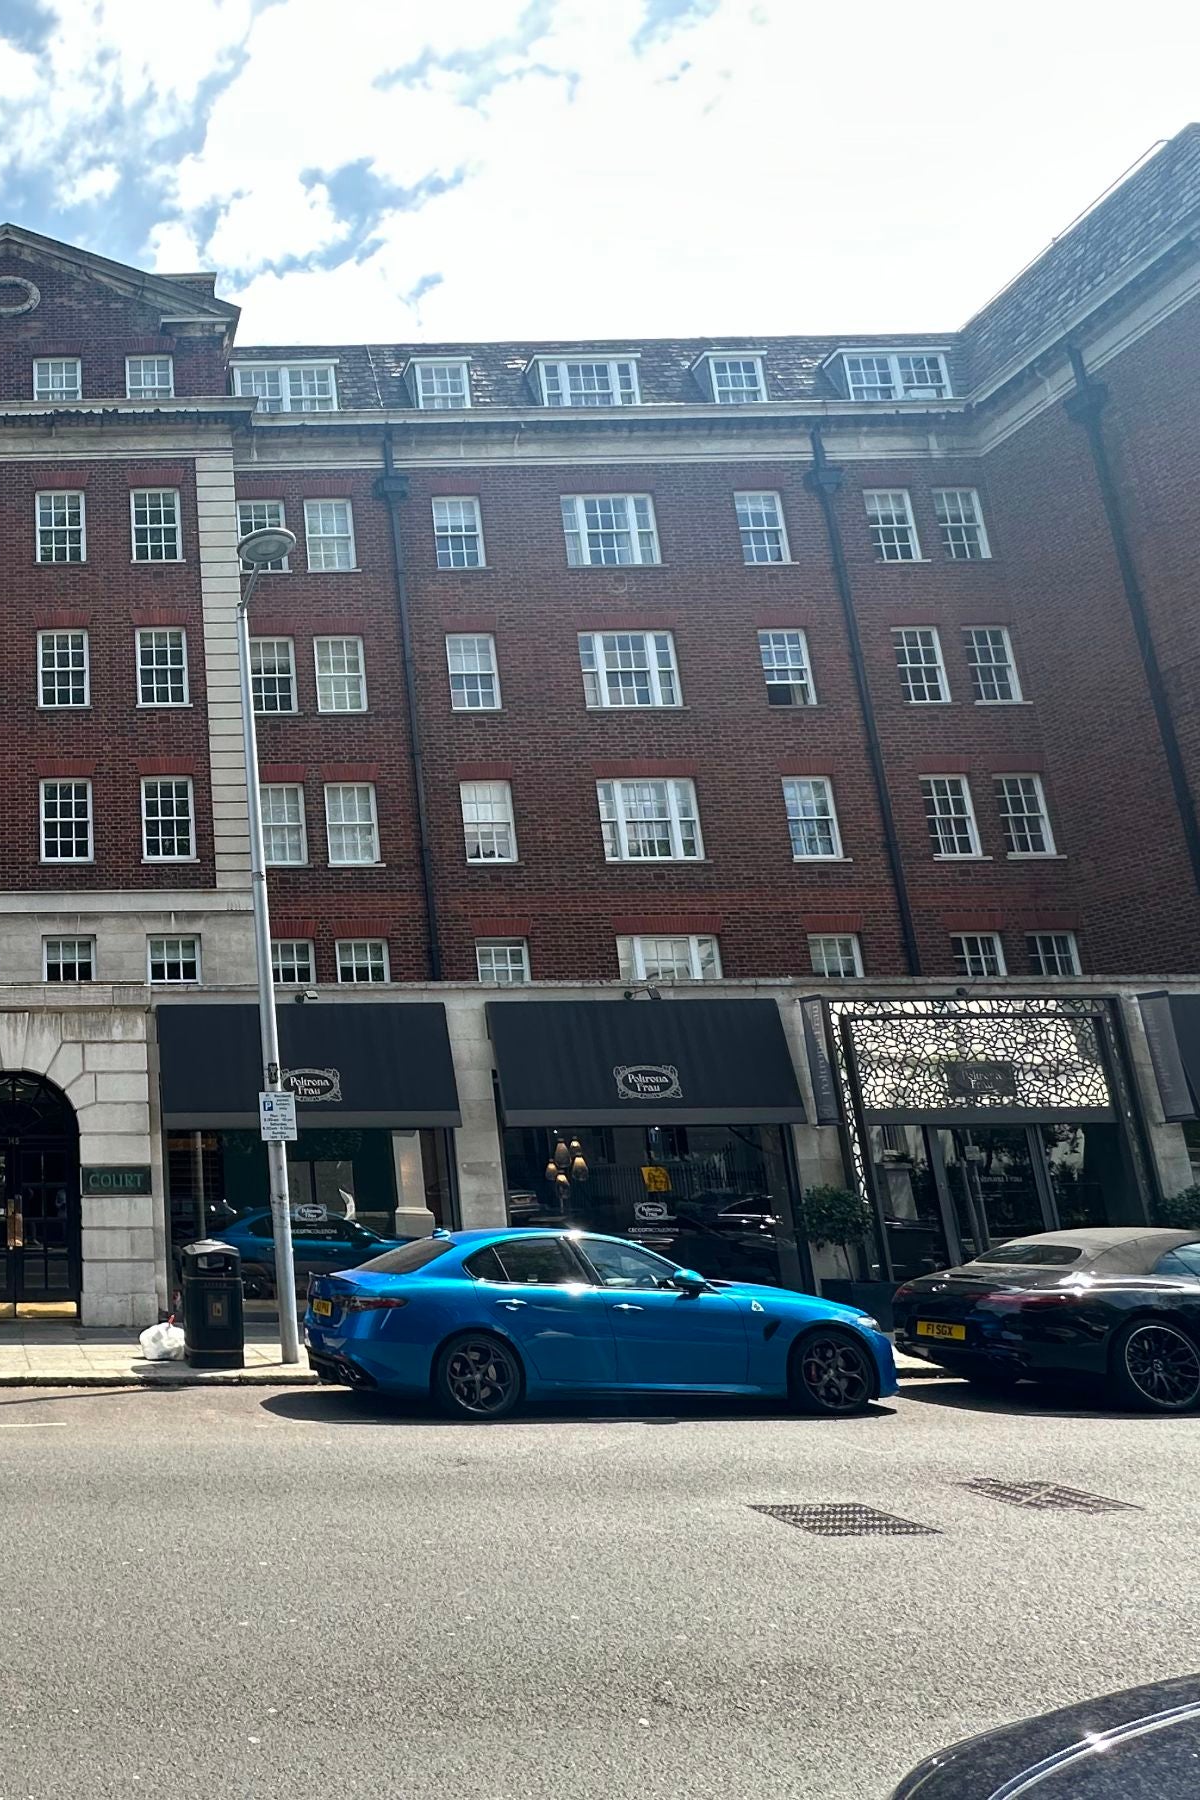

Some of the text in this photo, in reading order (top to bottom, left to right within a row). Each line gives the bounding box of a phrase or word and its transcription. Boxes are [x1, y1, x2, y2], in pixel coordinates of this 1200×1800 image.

[290, 1076, 330, 1087] Poltrona
[628, 1073, 669, 1084] Poltrona
[298, 1085, 321, 1095] Frau
[636, 1083, 661, 1092] Frau
[88, 1172, 145, 1188] COURT
